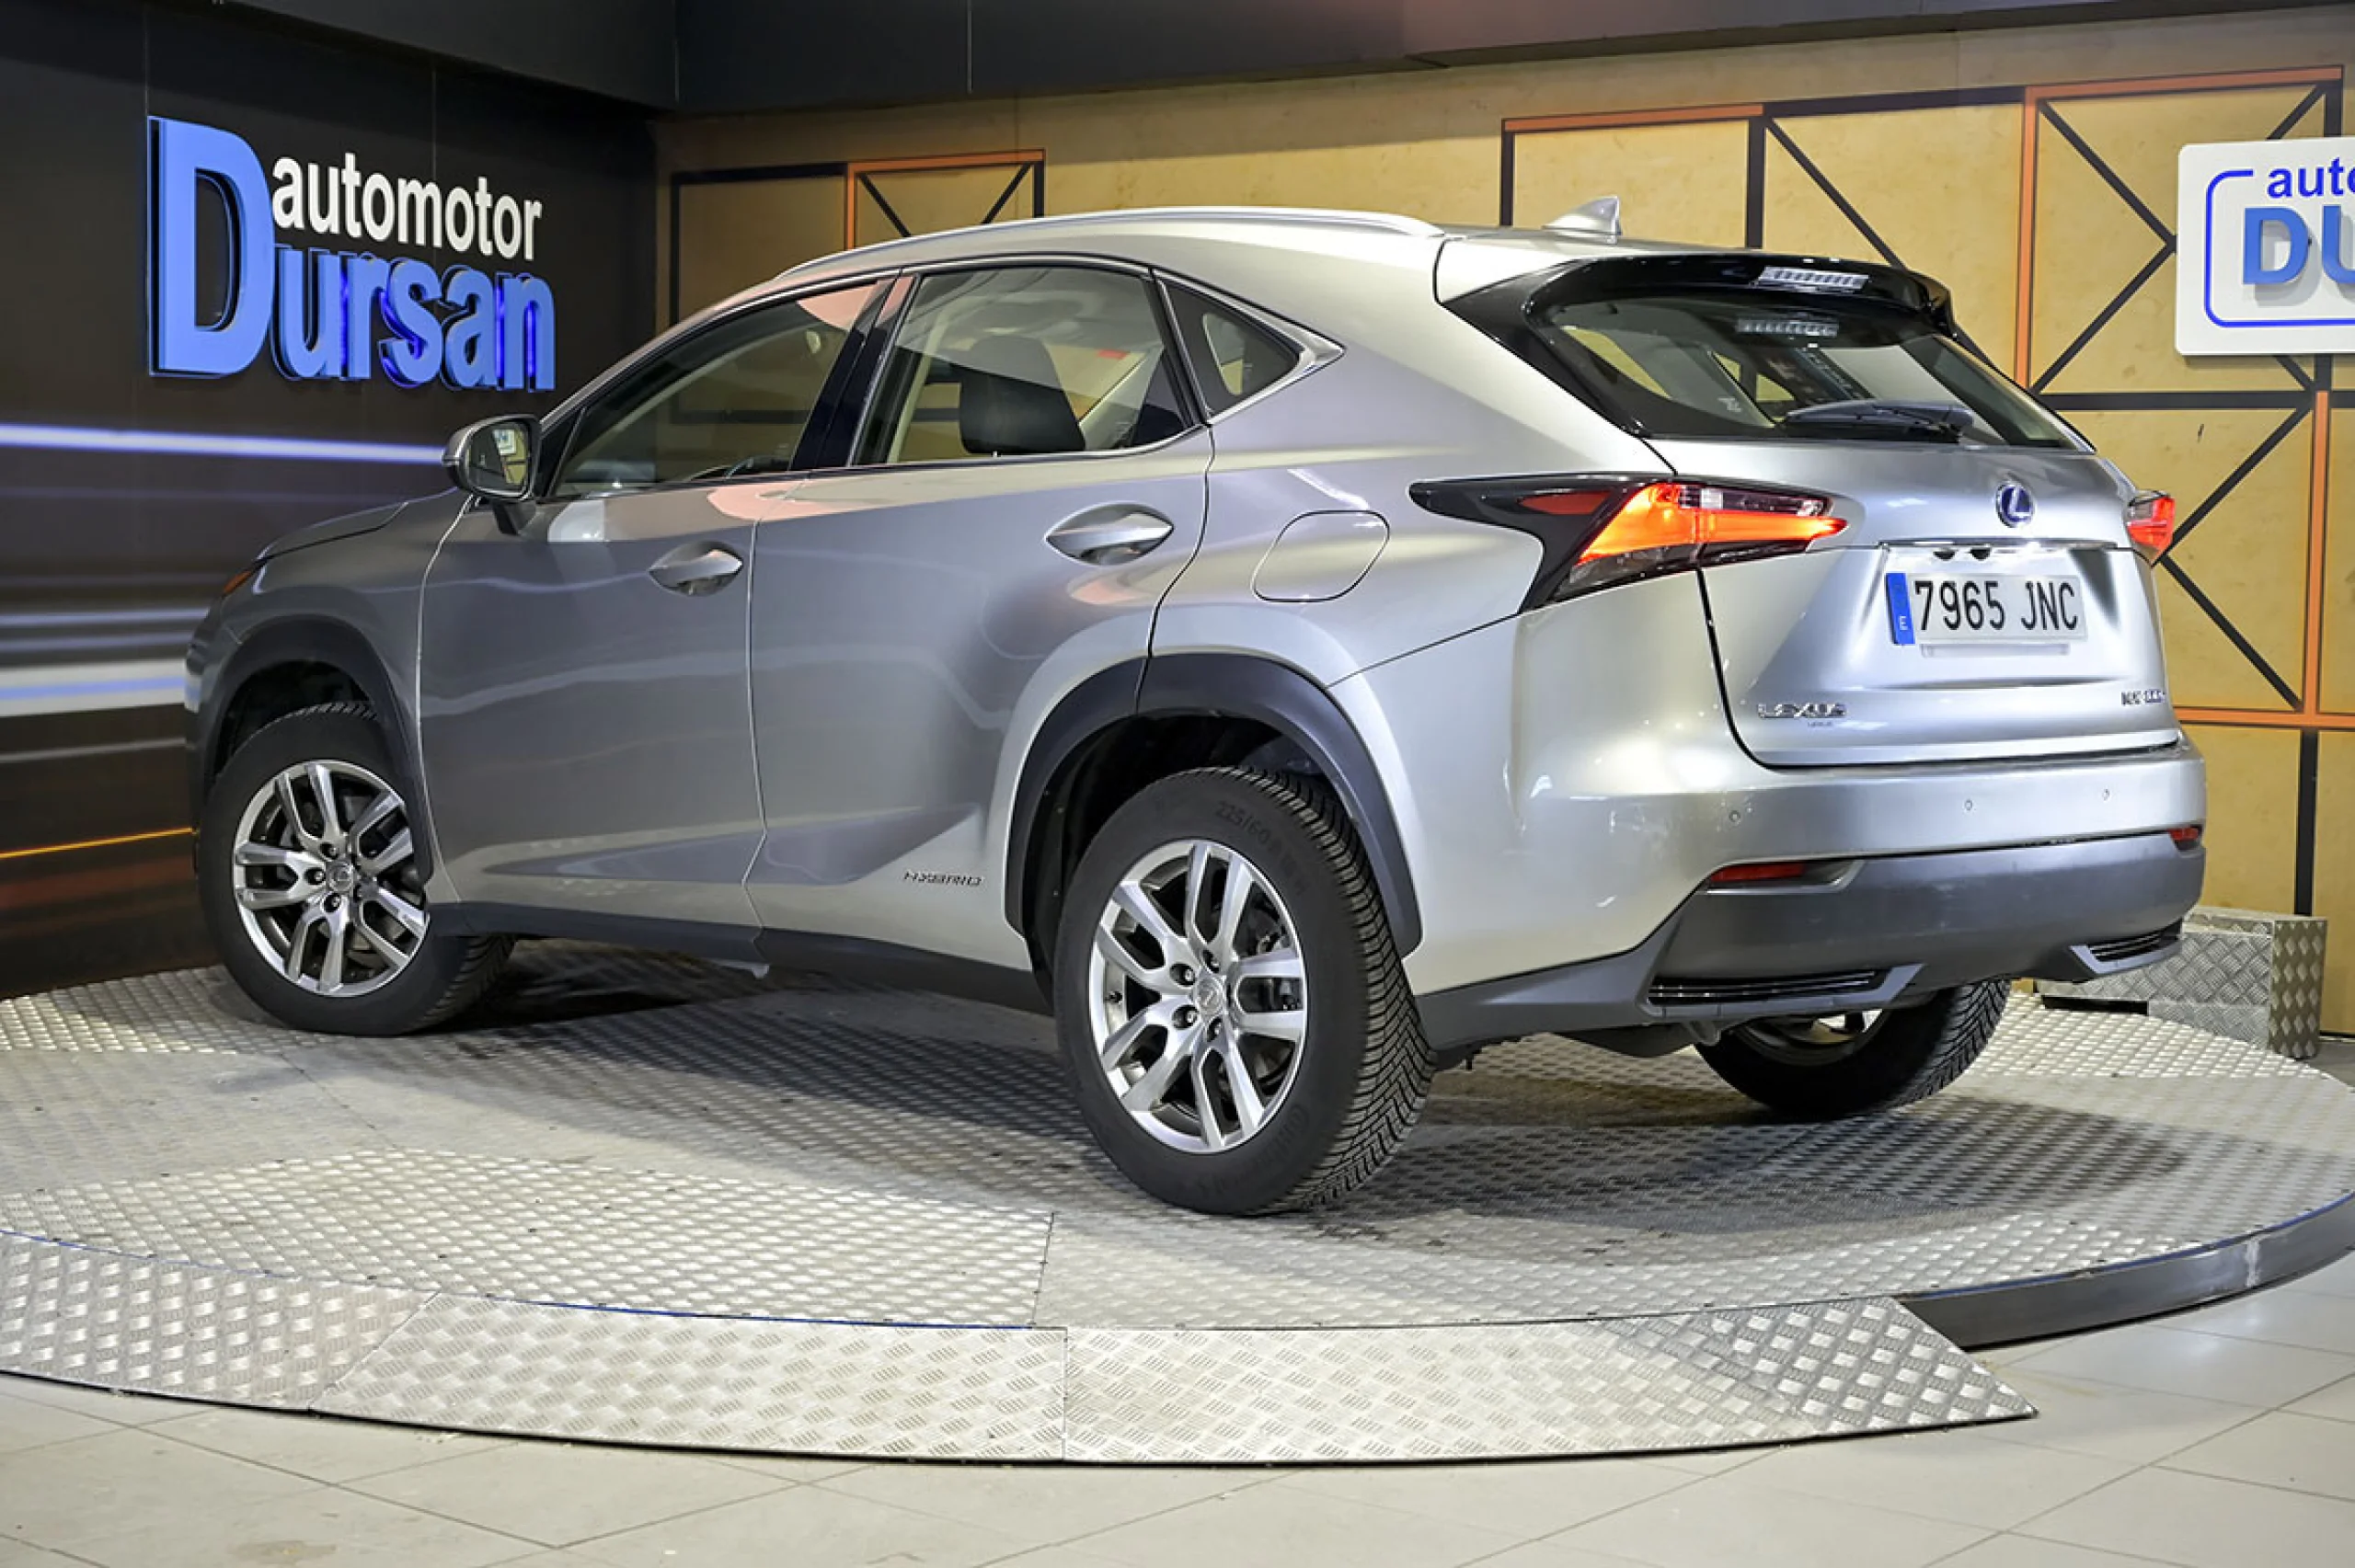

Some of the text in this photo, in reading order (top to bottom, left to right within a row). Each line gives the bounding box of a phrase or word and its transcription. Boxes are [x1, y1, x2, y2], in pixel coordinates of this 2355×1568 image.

[272, 152, 543, 260] automotor
[147, 115, 556, 393] Dursan
[1899, 615, 1909, 631] E
[1914, 580, 2078, 631] 7965 JNC
